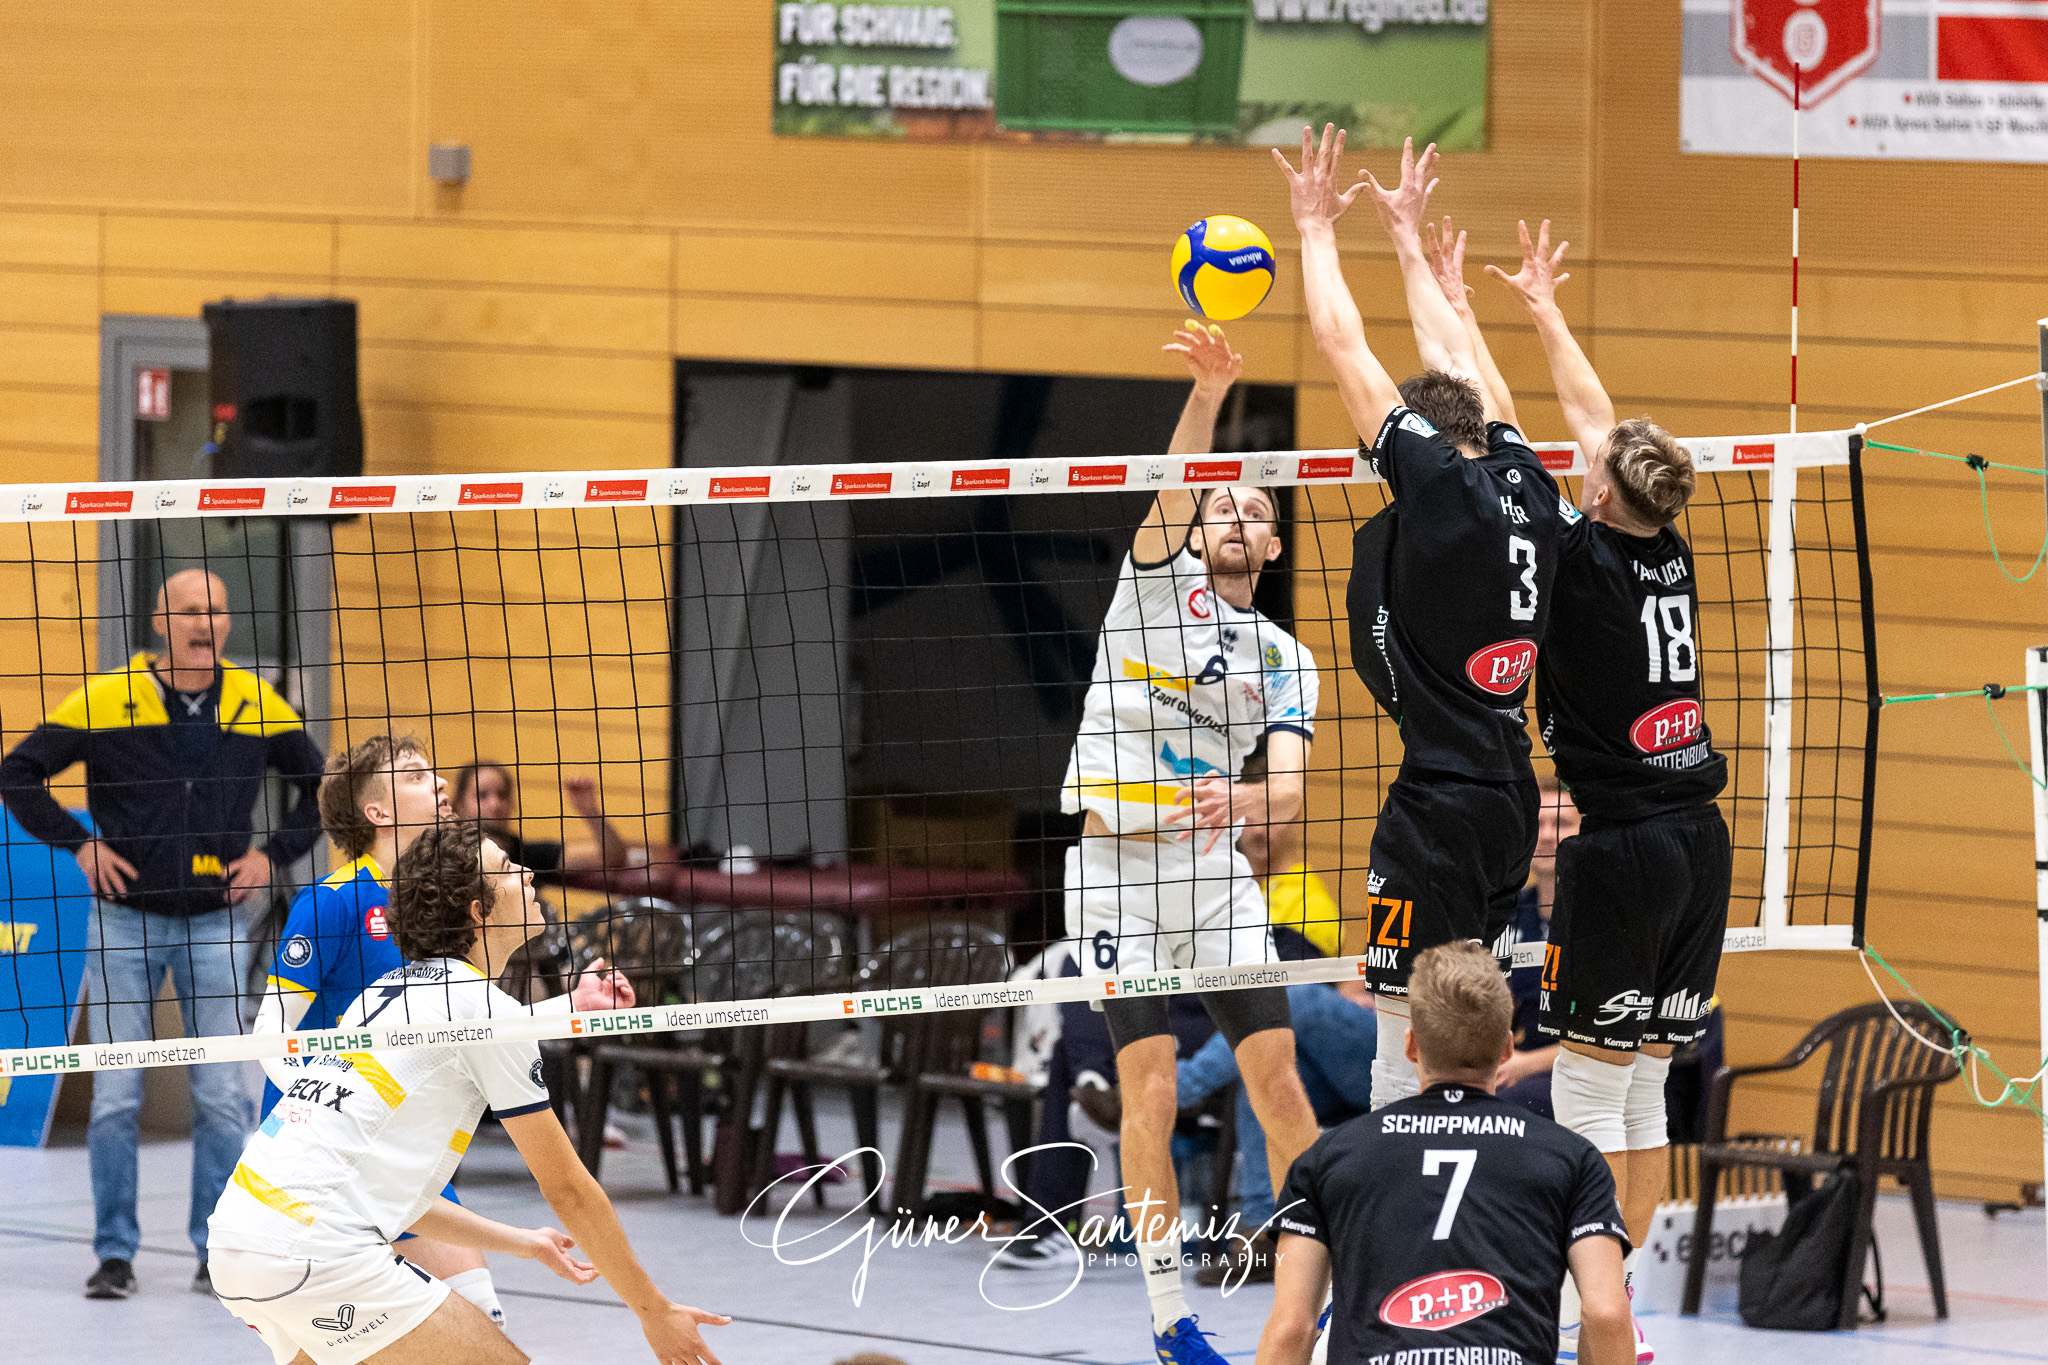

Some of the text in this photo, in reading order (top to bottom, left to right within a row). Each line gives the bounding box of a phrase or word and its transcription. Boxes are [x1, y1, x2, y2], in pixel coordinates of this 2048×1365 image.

[779, 55, 836, 105] FÜR
[838, 63, 885, 106] DIE
[964, 478, 985, 486] Sparkasse
[1036, 476, 1048, 484] Zapf
[1080, 474, 1102, 482] Sparkasse
[796, 484, 810, 492] Zapf
[843, 482, 866, 490] Sparkasse
[917, 480, 930, 489] Zapf
[550, 490, 564, 500] Zapf
[599, 489, 622, 497] Sparkasse
[674, 488, 688, 496] Zapf
[722, 486, 744, 494] Sparkasse
[293, 496, 308, 505] Zapf
[344, 494, 367, 502] Sparkasse
[422, 494, 436, 502] Zapf
[472, 492, 496, 500] Sparkasse
[80, 500, 104, 509] Sparkasse
[160, 498, 176, 508] Zapf
[212, 497, 236, 506] Sparkasse
[27, 502, 42, 512] Zapf
[1509, 535, 1539, 621] 3
[1640, 594, 1697, 683] 18
[1092, 930, 1117, 969] 6
[1123, 970, 1288, 994] FUCHS Ideen umsetzen
[862, 988, 1034, 1013] FUCHS Ideen umsetzen
[590, 1007, 769, 1032] FUCHS Ideen umsetzen
[307, 1026, 493, 1052] FUCHS Ideen umsetzen
[1567, 1030, 1596, 1043] Kempa
[1604, 1037, 1633, 1049] Kempa
[12, 1046, 206, 1072] FUCHS Ideen umsetzen
[287, 1078, 331, 1104] ECK
[1381, 1114, 1526, 1138] SCHIPPMANN
[1421, 1149, 1478, 1241] 7
[1280, 1217, 1316, 1235] Kempa
[1571, 1221, 1604, 1239] Kempa
[1408, 1278, 1485, 1324] p+p
[1394, 1346, 1523, 1365] ROTTENBURG
